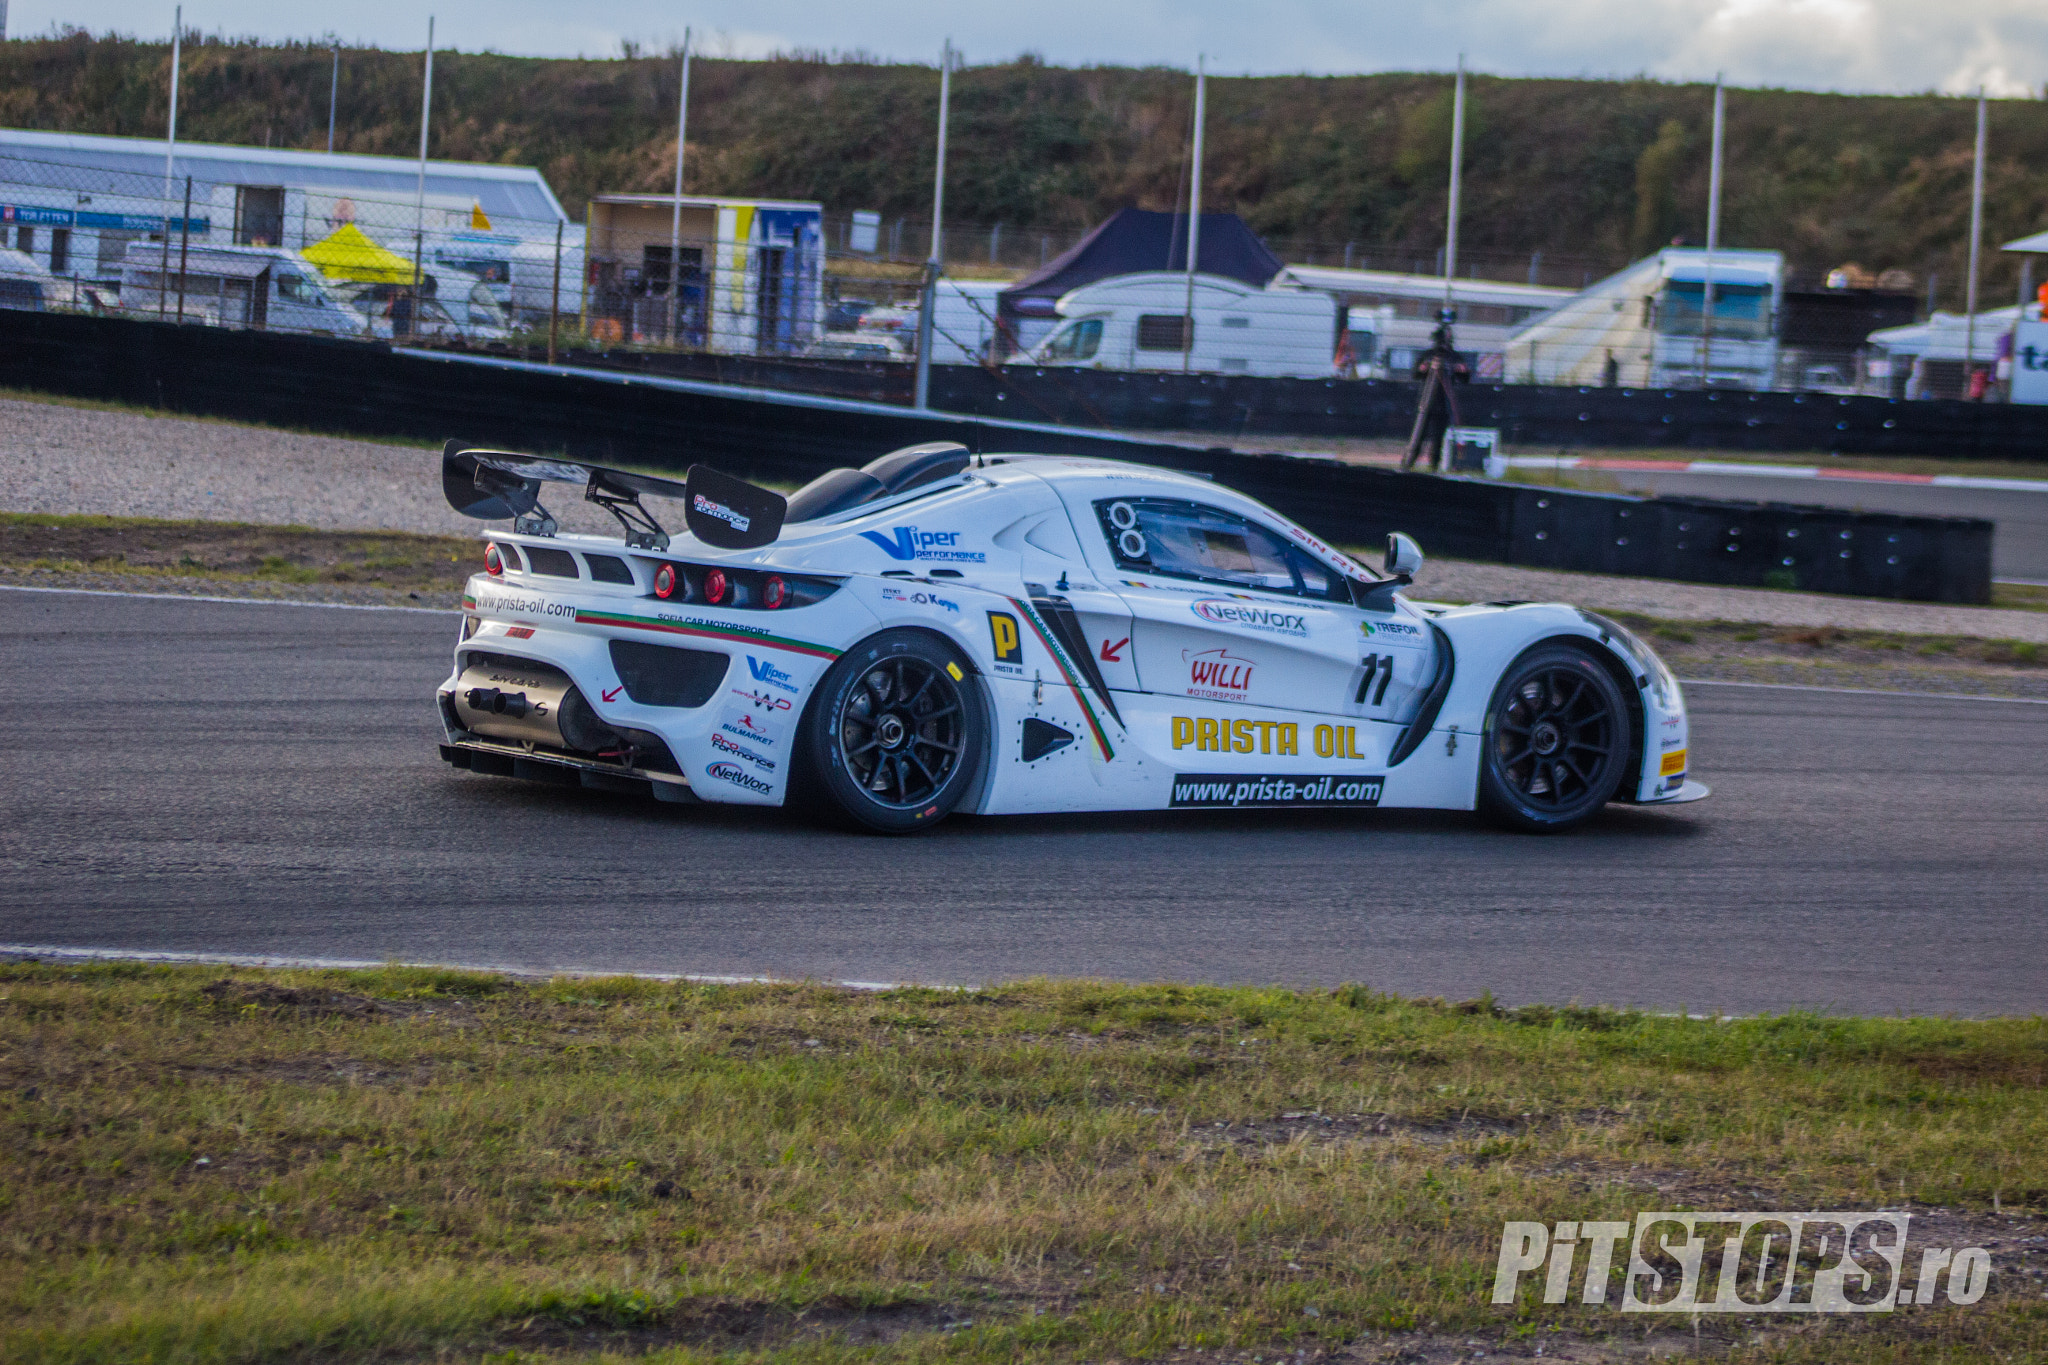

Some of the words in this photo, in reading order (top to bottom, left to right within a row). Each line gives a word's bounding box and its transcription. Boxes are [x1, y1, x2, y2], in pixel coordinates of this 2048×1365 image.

[856, 525, 960, 561] Viper
[1290, 528, 1326, 553] SIN
[477, 595, 576, 618] www.prista-oil.com
[1202, 603, 1306, 631] NetWorx
[657, 613, 683, 624] SOFIA
[685, 616, 704, 626] CAR
[705, 619, 771, 637] MOTORSPORT
[991, 615, 1017, 658] P
[1374, 622, 1421, 635] TREFOIL
[746, 655, 792, 682] Viper
[1191, 660, 1253, 690] WILLI
[1354, 653, 1393, 706] 11
[1186, 687, 1248, 701] MOTORSPORT
[711, 733, 739, 750] Pro
[722, 723, 774, 746] BULMARKET
[1171, 716, 1299, 756] PRISTA
[1313, 724, 1366, 760] OIL
[712, 740, 776, 769] Formance
[713, 765, 773, 793] NetWorx
[1175, 776, 1381, 807] www.prista-oil.com
